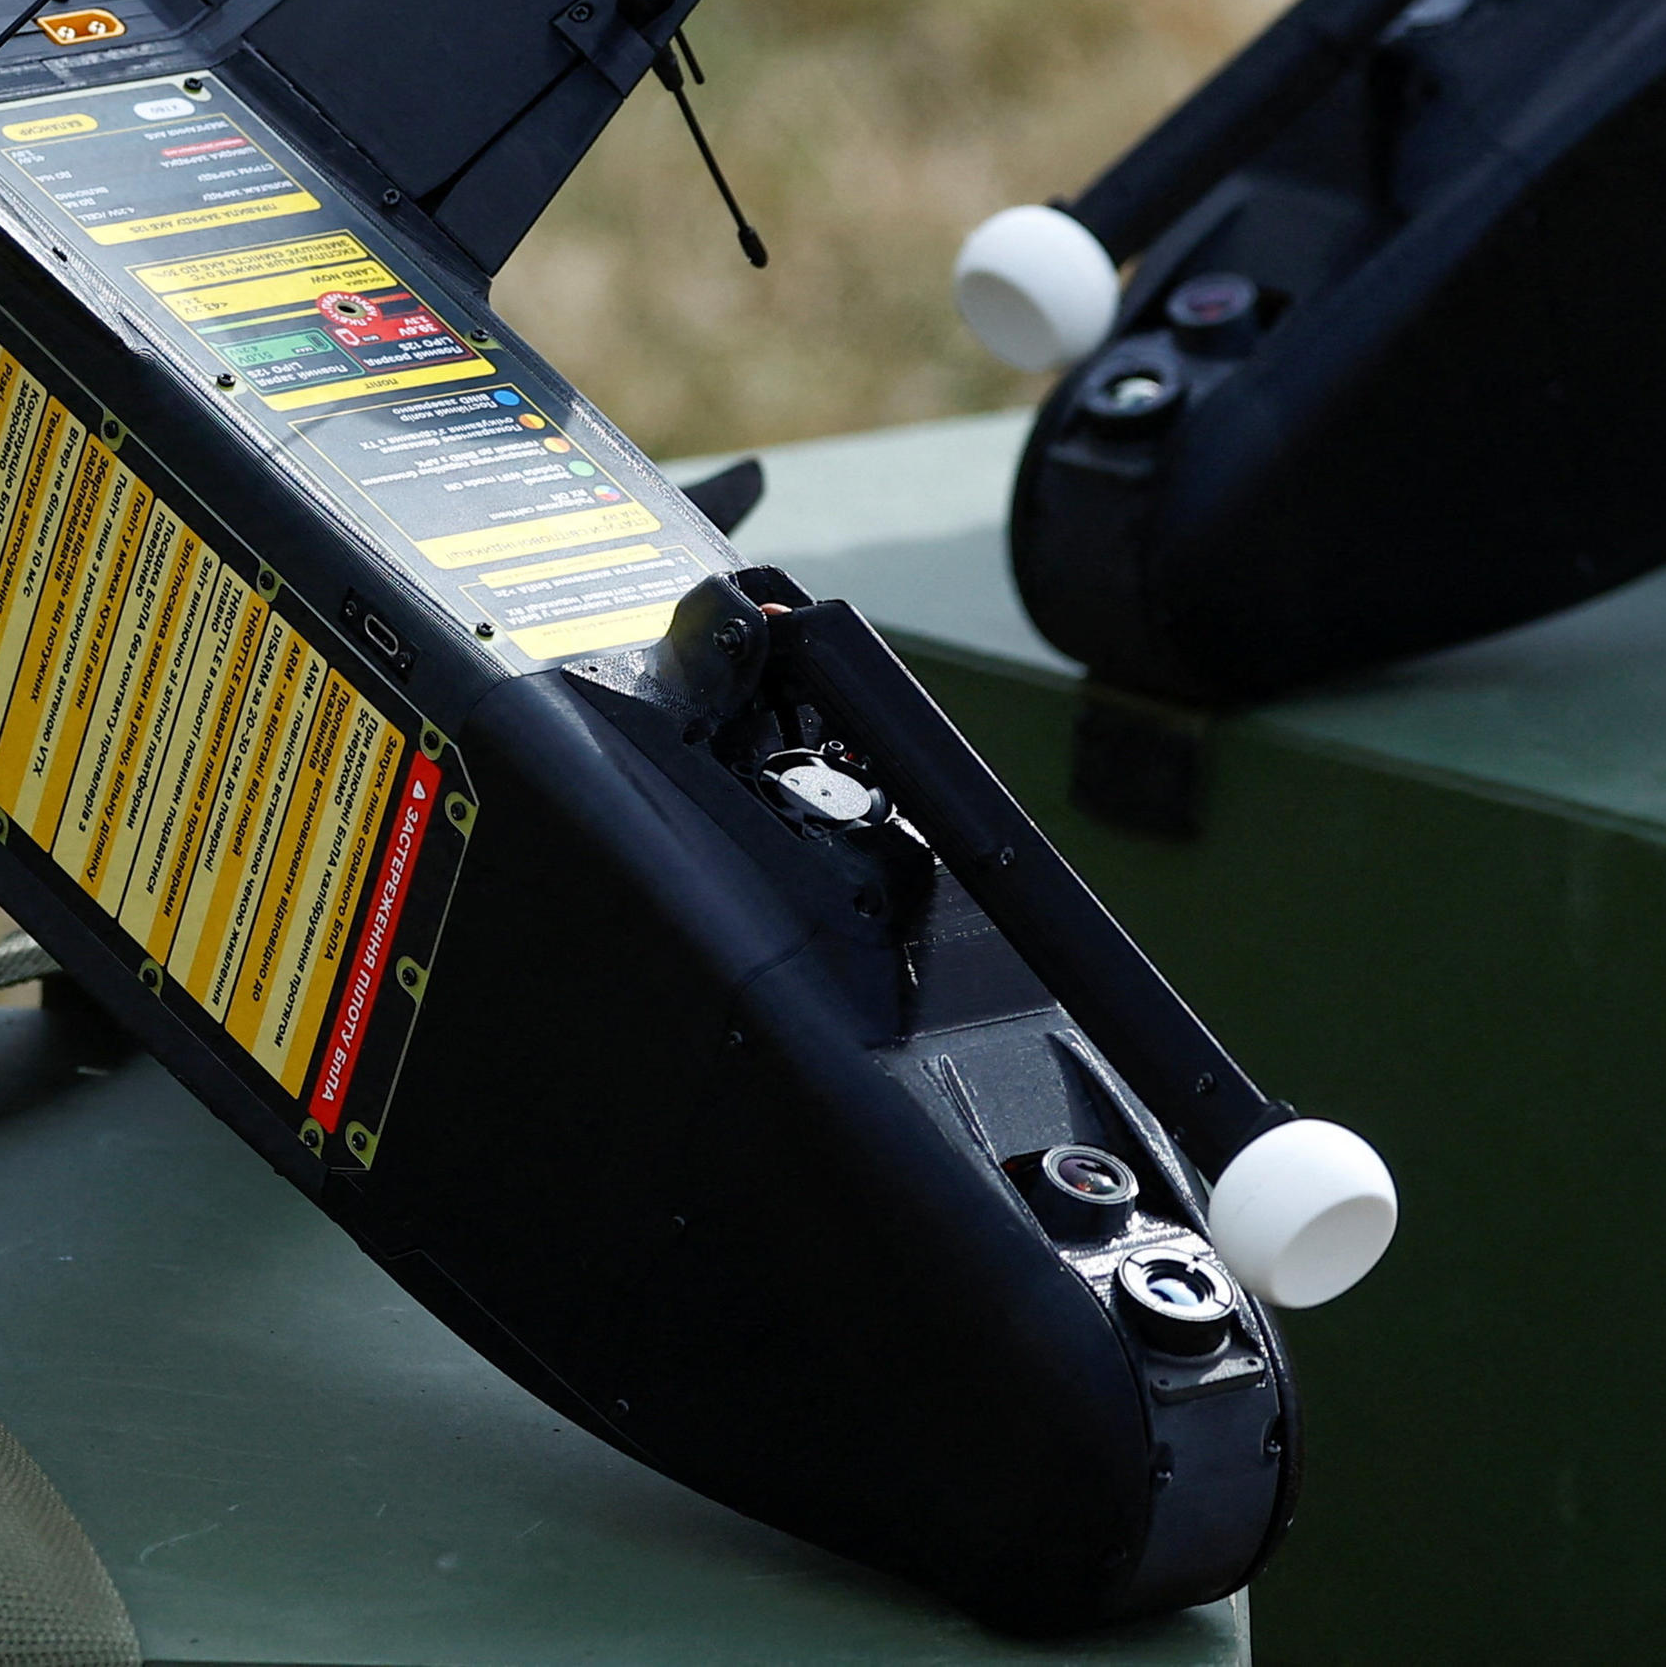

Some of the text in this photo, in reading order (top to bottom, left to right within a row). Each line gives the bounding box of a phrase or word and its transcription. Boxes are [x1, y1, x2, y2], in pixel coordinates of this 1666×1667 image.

[306, 265, 379, 284] LAND NOW
[361, 343, 464, 368] Повний розряд
[394, 321, 439, 337] 39.6V
[252, 363, 350, 387] Повний заряд
[388, 392, 491, 416] BIND завершено
[397, 398, 499, 423] Постійний колір
[4, 389, 39, 488] Конструкцію
[25, 411, 60, 508] Температура
[22, 426, 79, 597] Вітер не більше 10 м/с
[54, 445, 98, 580] радіопередавачів
[30, 455, 109, 702] Зберігати відстань від потужних
[135, 511, 165, 597] поверхнею
[32, 473, 127, 777] Політ лише з розгорнутою антеною VTX
[75, 491, 146, 709] Політ у межах кута дії антен
[211, 576, 232, 632] плавно
[78, 520, 175, 832] Посадка БпЛА без контакту пропелерів з
[126, 556, 212, 829] Зліт виключно зі злітної платформи
[258, 624, 282, 687] DISARM
[283, 641, 300, 681] ARM
[302, 659, 319, 699] ARM
[86, 539, 193, 882] Зліт/посадка завжди на рівну, вільну ділянку
[251, 686, 262, 705] за
[273, 691, 285, 712] на
[308, 681, 339, 769] вказівників
[146, 588, 242, 893] THROTTLE в польоті повинен подаватися
[163, 606, 261, 916] THROTTLE подавати лише з пропелерами
[230, 755, 242, 778] см
[255, 714, 278, 778] відстані
[277, 710, 303, 781] повністю
[334, 729, 361, 805] нерухомо
[224, 776, 235, 800] до
[245, 777, 259, 803] від
[204, 801, 228, 872] поверхні
[232, 803, 251, 856] людей
[250, 783, 281, 874] вставленою
[252, 690, 350, 1001] Пропелери встановлювати відповідно до
[324, 735, 397, 960] Запуск лише справного БпЛА
[235, 878, 254, 926] чекою
[274, 717, 378, 1047] При включені БпЛА калібрування протягом
[211, 927, 238, 1004] живлення
[322, 807, 417, 1100] ЗАСТЕРЕЖЕННЯ ПІЛОТУ БпЛА
